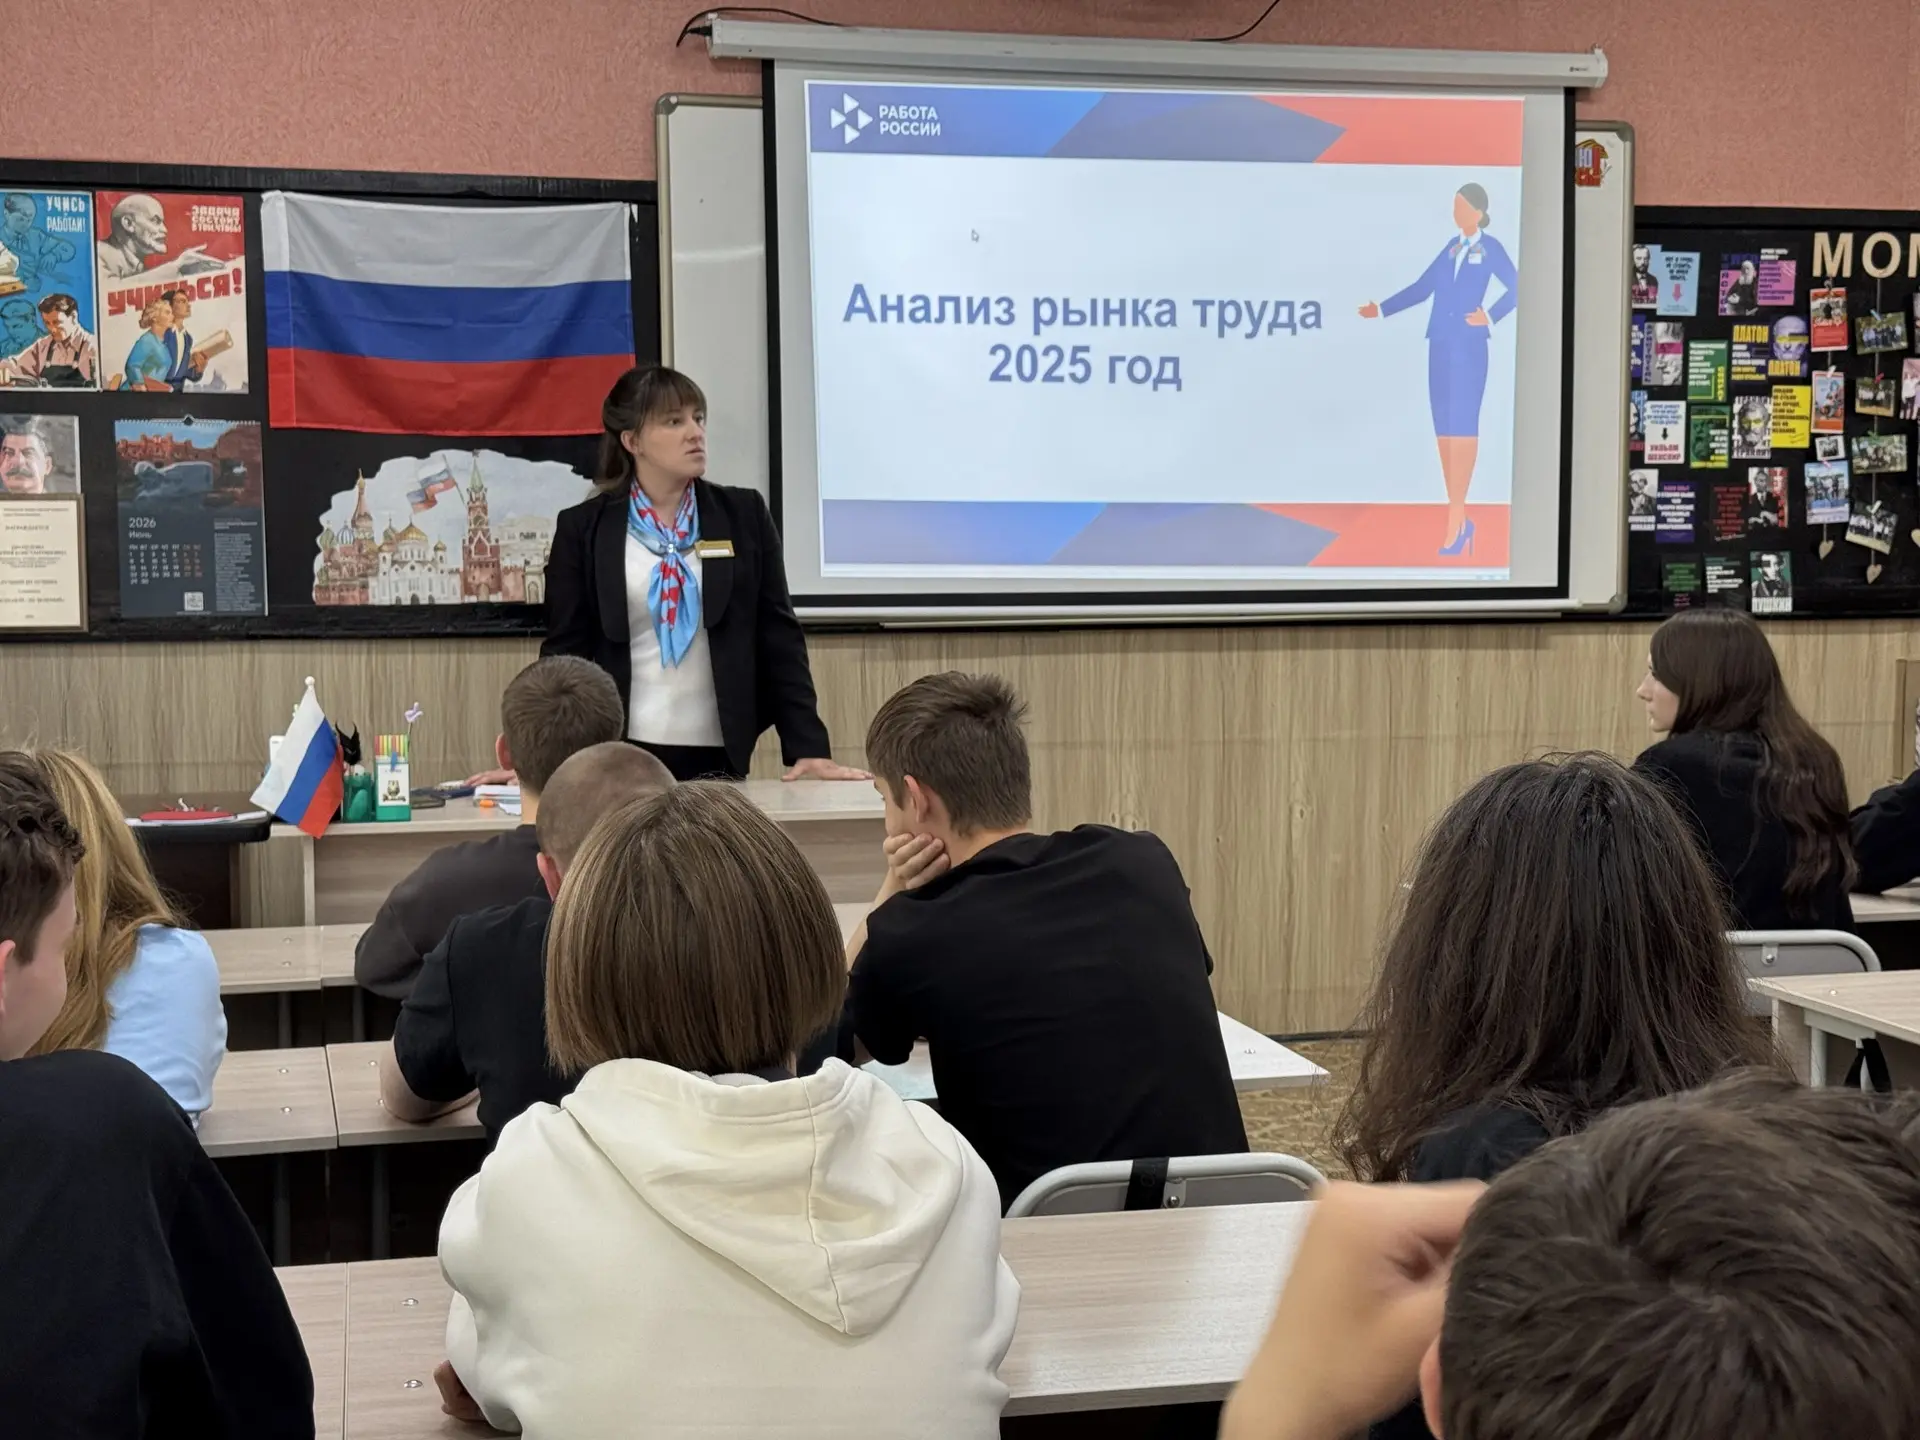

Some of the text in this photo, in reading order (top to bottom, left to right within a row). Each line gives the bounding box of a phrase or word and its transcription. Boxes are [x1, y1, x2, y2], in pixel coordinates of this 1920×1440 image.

[879, 105, 938, 121] РАБОТА
[880, 121, 942, 137] РОССИИ
[46, 195, 86, 213] УЧИСЬ
[843, 284, 1323, 339] Анализ рынка труда
[988, 343, 1182, 391] 2025 год
[129, 517, 156, 528] 2026
